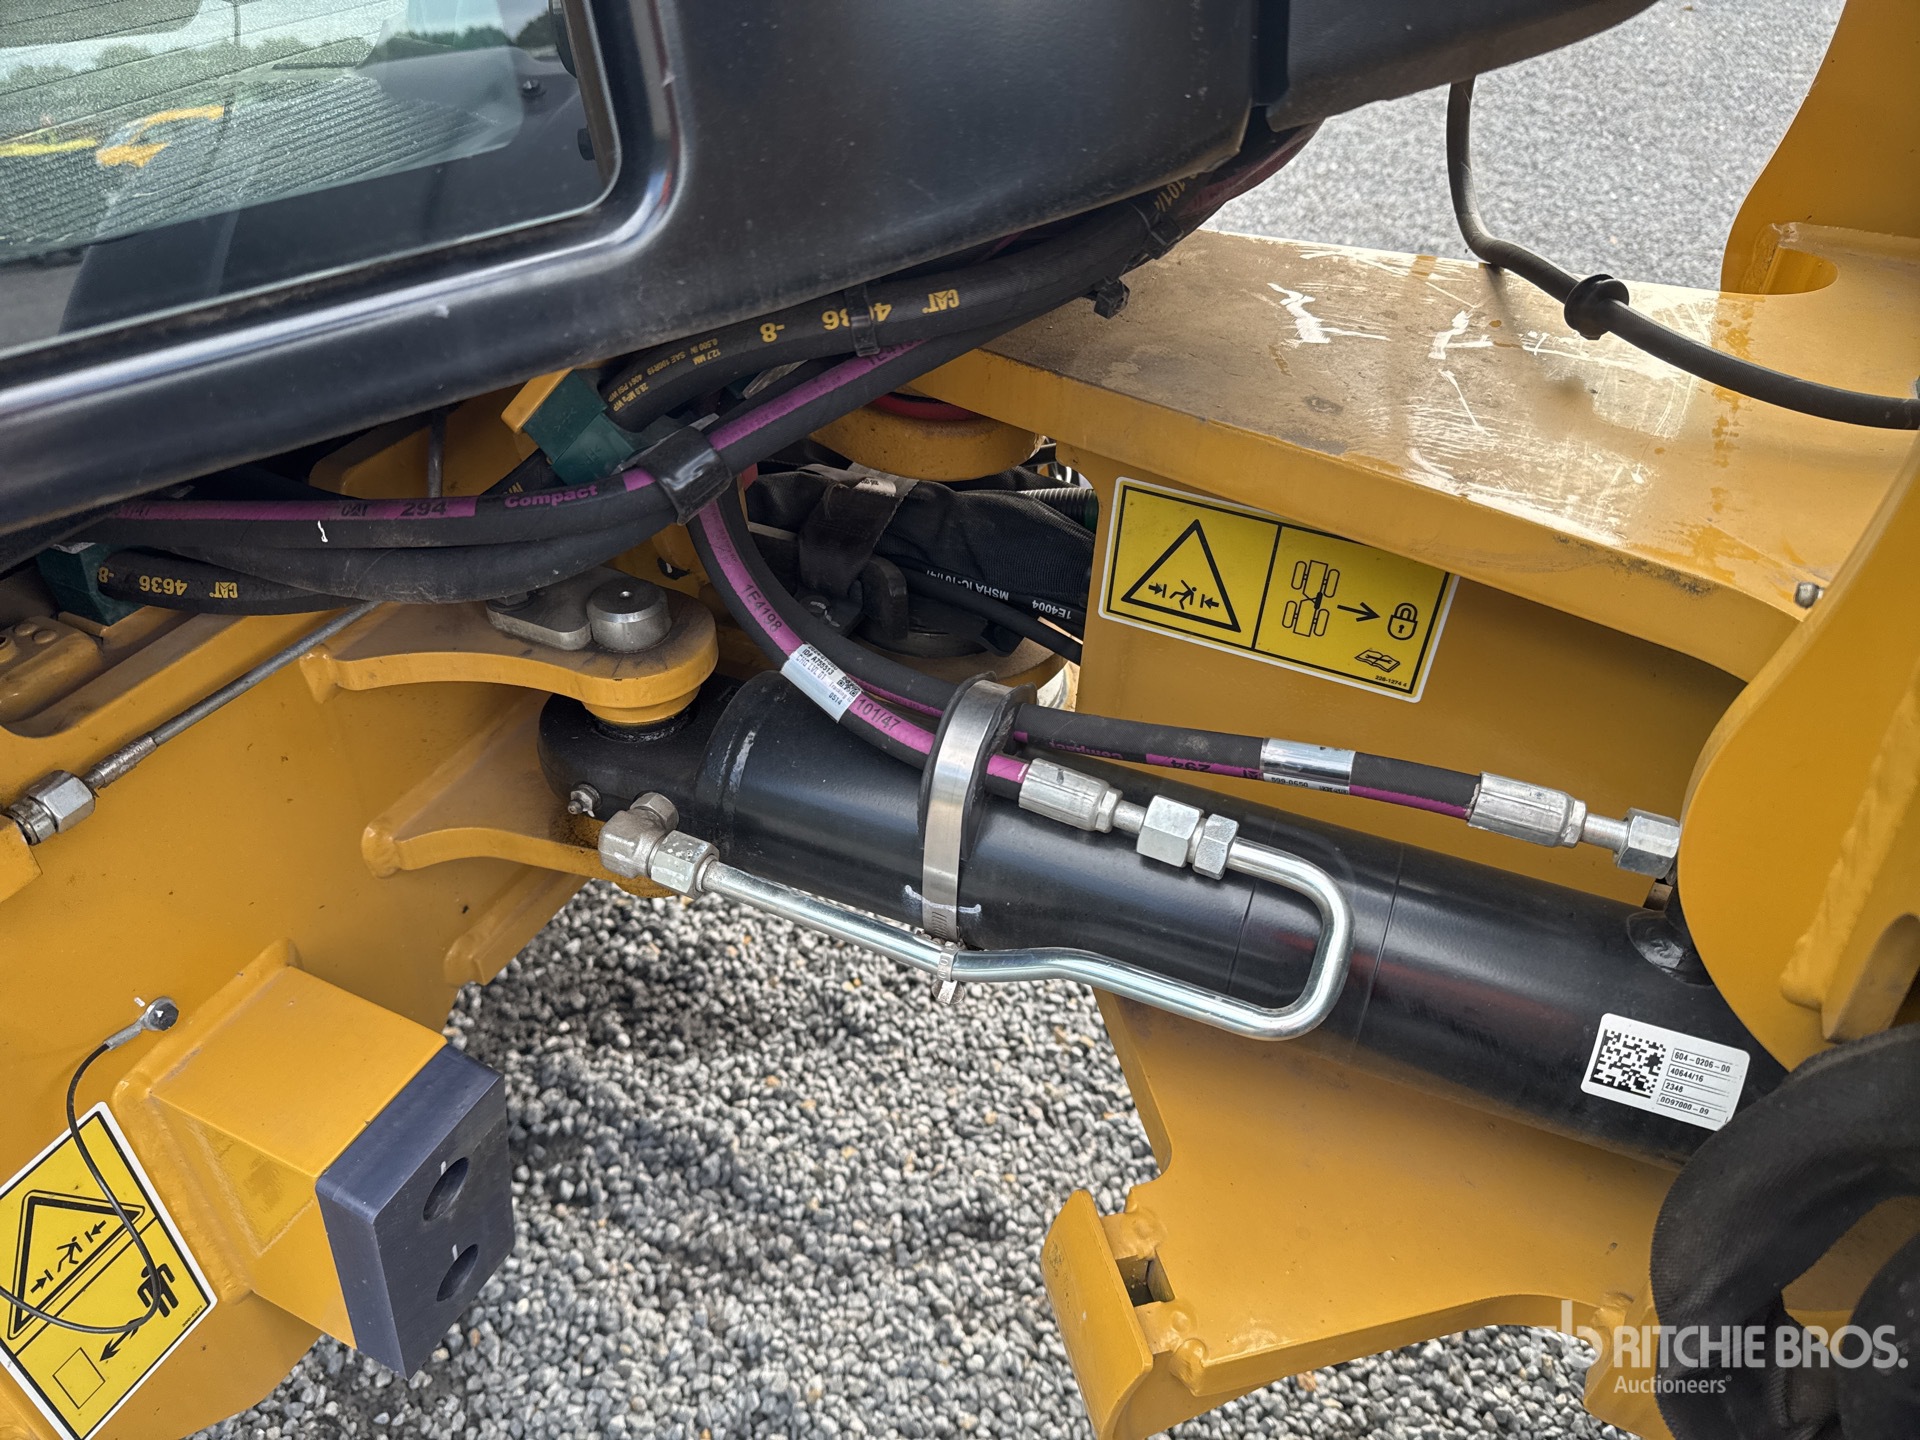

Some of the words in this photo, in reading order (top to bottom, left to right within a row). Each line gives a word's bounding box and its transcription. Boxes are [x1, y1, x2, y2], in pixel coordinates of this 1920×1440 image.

[922, 288, 960, 314] CAT
[822, 302, 892, 330] 436
[759, 322, 785, 343] -8
[400, 501, 447, 517] 294
[504, 484, 598, 508] Compact
[98, 567, 114, 583] -8
[139, 575, 188, 596] 4636
[209, 581, 238, 598] CAT
[976, 583, 1009, 600] MSHA
[741, 584, 783, 632] 1E4198
[1032, 600, 1072, 620] 1E4004
[856, 698, 900, 731] 101/47
[1670, 1068, 1704, 1082] 40644/16
[1665, 1082, 1684, 1092] 2348
